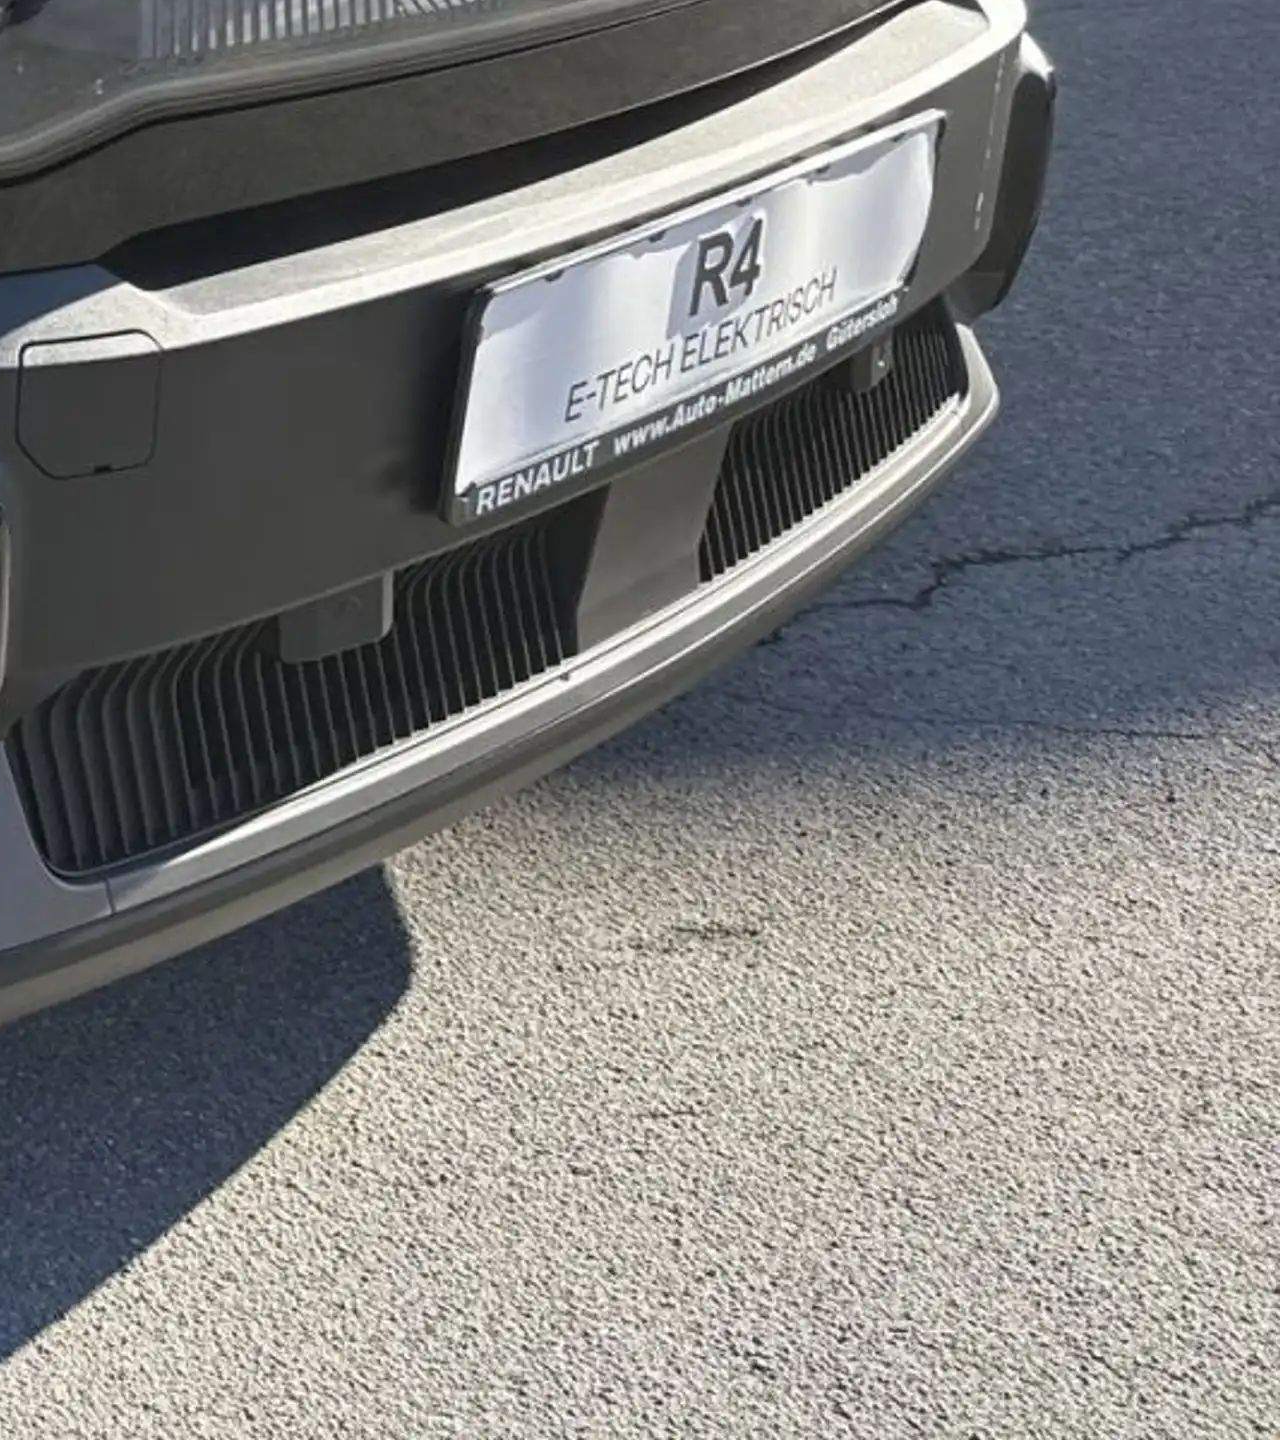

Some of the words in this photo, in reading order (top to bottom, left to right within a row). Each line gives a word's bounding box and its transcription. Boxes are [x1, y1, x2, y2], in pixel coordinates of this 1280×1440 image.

[563, 343, 675, 423] E-TECH
[680, 266, 838, 373] ELEKTRISCH
[688, 217, 763, 318] R4
[475, 440, 600, 516] RENAULT
[612, 342, 818, 456] www.Auto-Mattern.de
[825, 292, 899, 352] Gütersloh
